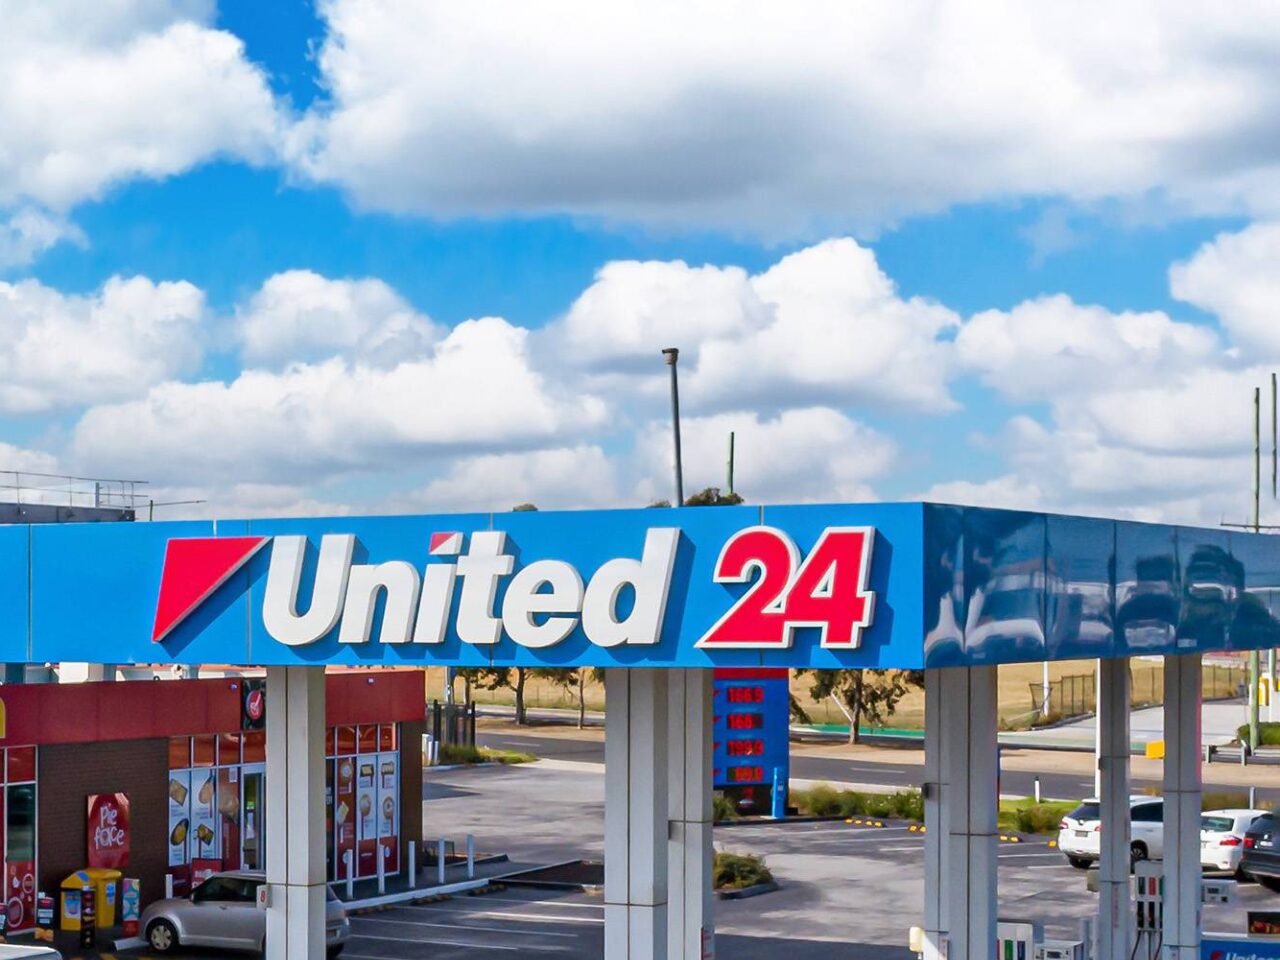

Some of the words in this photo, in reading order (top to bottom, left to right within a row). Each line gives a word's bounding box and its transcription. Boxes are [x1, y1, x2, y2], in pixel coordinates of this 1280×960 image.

[263, 526, 681, 646] United
[694, 525, 876, 649] 24
[100, 803, 118, 828] Pie
